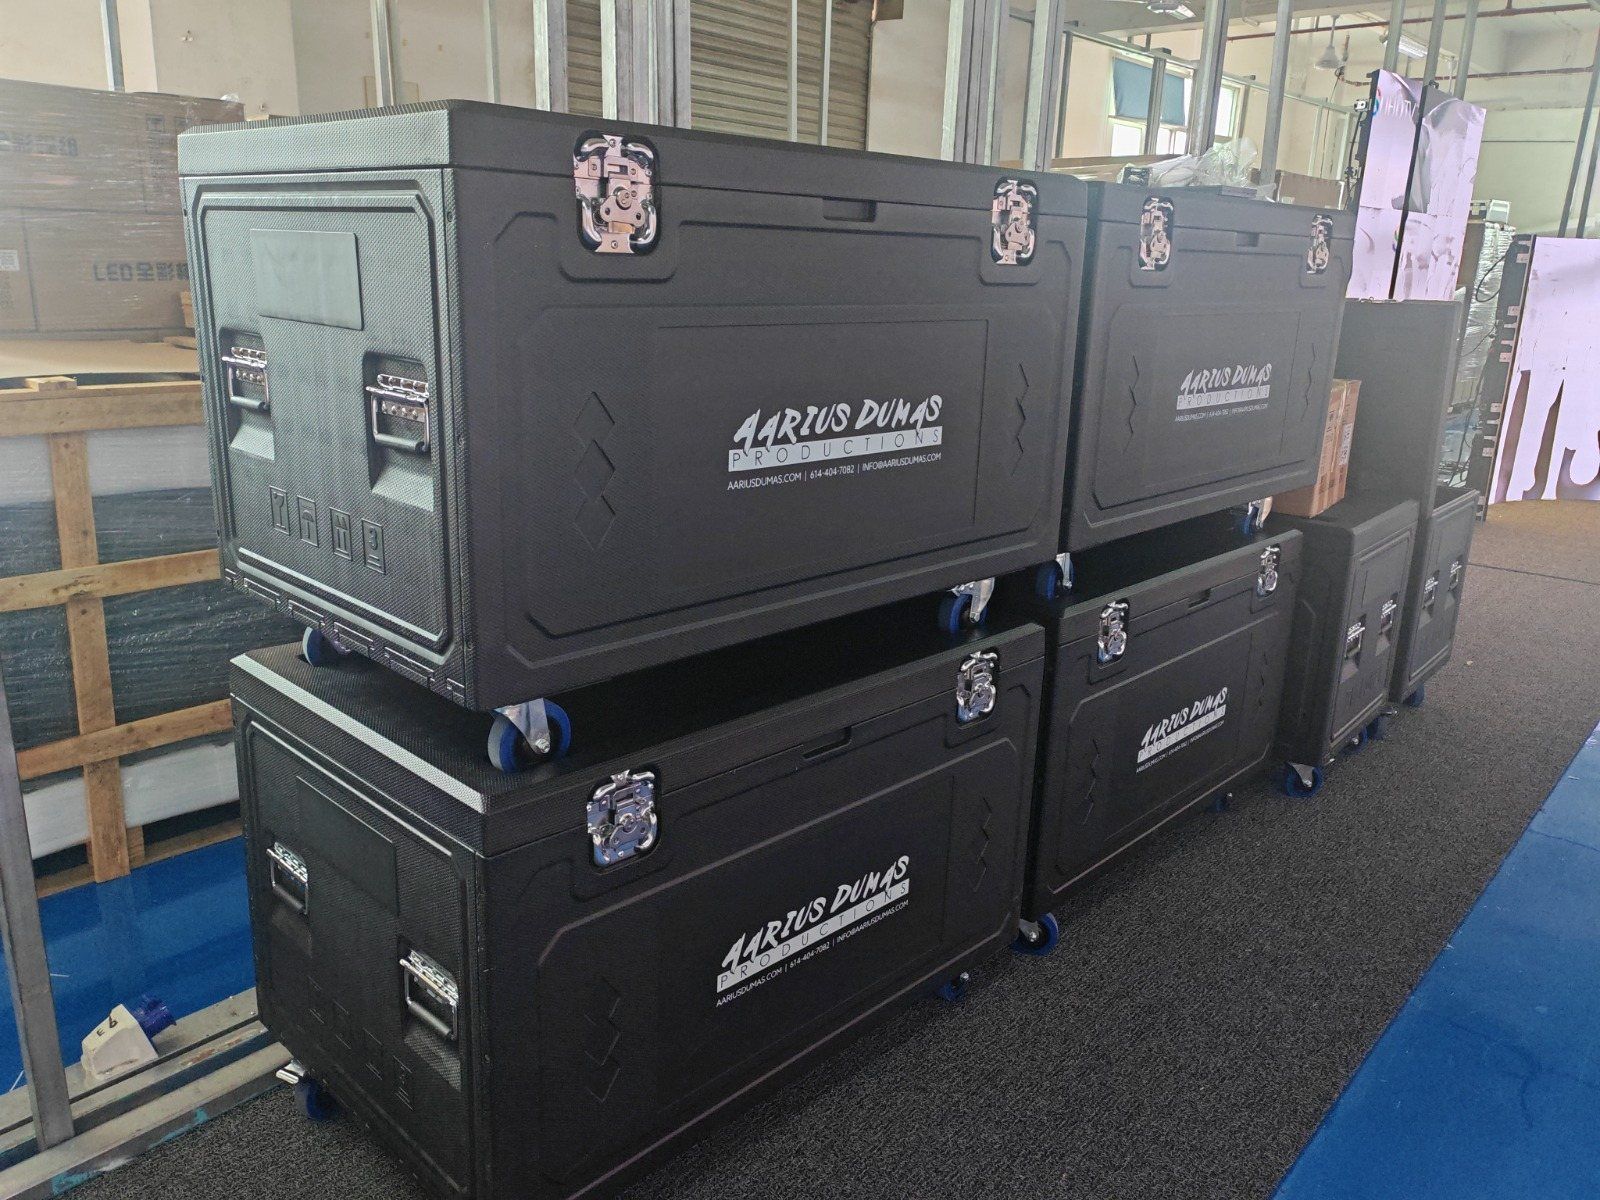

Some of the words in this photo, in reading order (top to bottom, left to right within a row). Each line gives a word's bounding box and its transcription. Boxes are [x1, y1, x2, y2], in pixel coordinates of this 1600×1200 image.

[1180, 366, 1232, 396] AARIUS
[1231, 363, 1272, 387] DUMAS
[732, 428, 939, 468] PRODUCTIONS
[733, 403, 850, 457] AARIUS
[855, 394, 943, 434] DUMAS
[727, 472, 802, 490] AARIUSDUMAS.COM
[809, 464, 855, 480] 614-404-7082
[862, 452, 942, 472] INFO@AARIUSDUMAS.COM
[1141, 707, 1189, 751] AARIUS
[1189, 687, 1228, 720] DUMAS
[720, 882, 906, 989] PRODUCTIONS
[721, 897, 827, 974] AARIUS
[830, 855, 910, 914] DUMAS
[716, 966, 783, 1008] AARIUSDUMAS.COM
[789, 941, 830, 969] 614-404-7082
[836, 899, 909, 943] INFO@AARIUSDUMAS.COM
